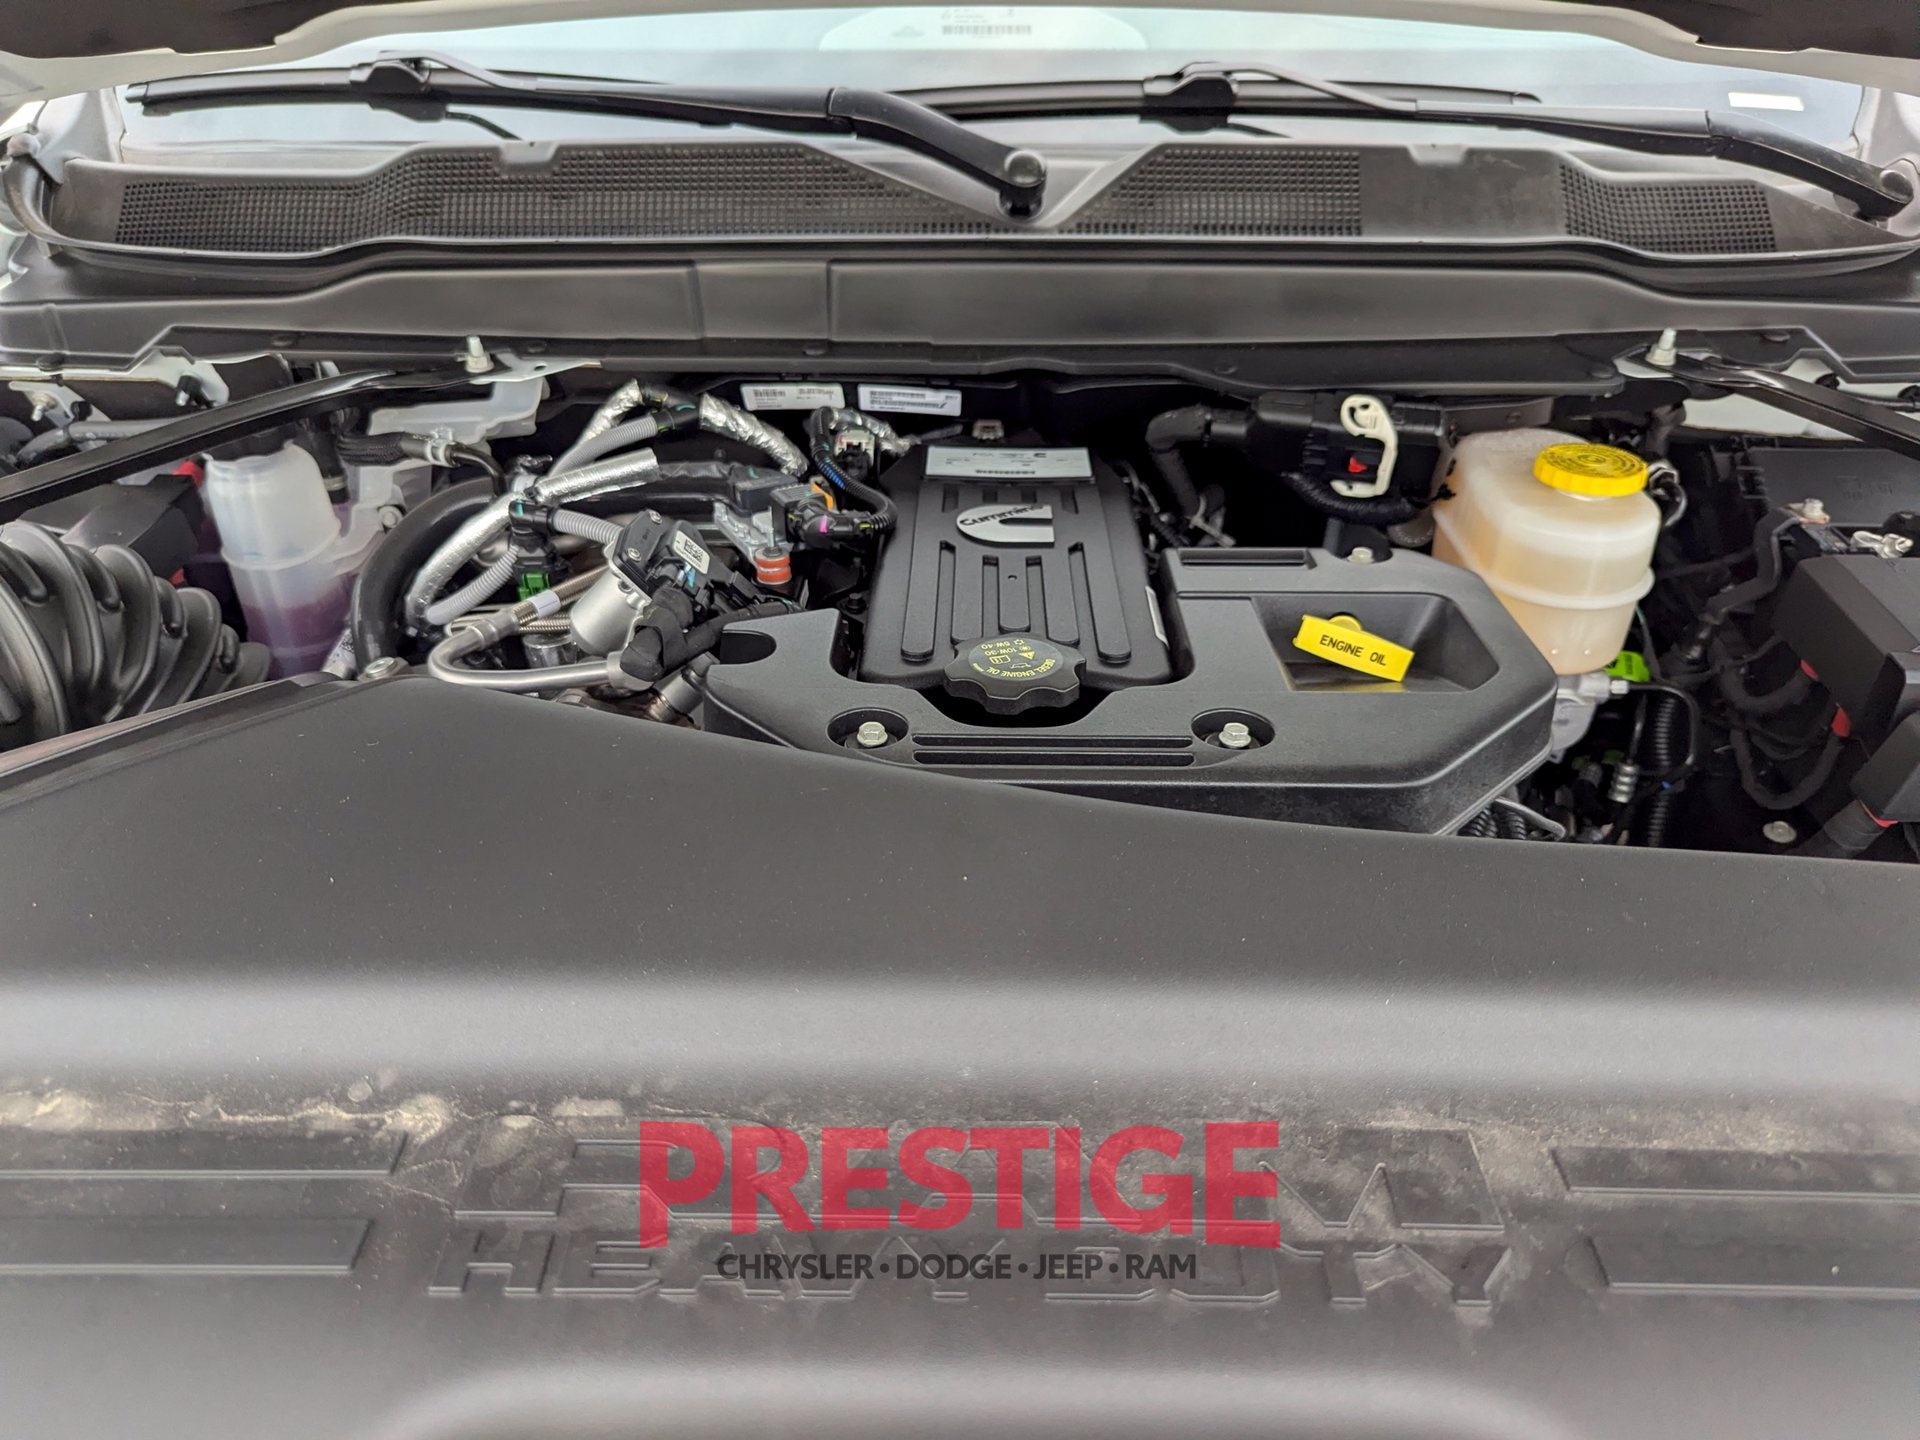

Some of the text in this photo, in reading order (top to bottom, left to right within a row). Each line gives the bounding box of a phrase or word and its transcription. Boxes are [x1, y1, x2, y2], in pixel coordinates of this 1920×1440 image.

[984, 647, 1017, 656] 10W-30
[1319, 634, 1387, 666] ENGINE OIL
[986, 666, 1000, 675] OIL
[1000, 669, 1036, 677] ENGINE
